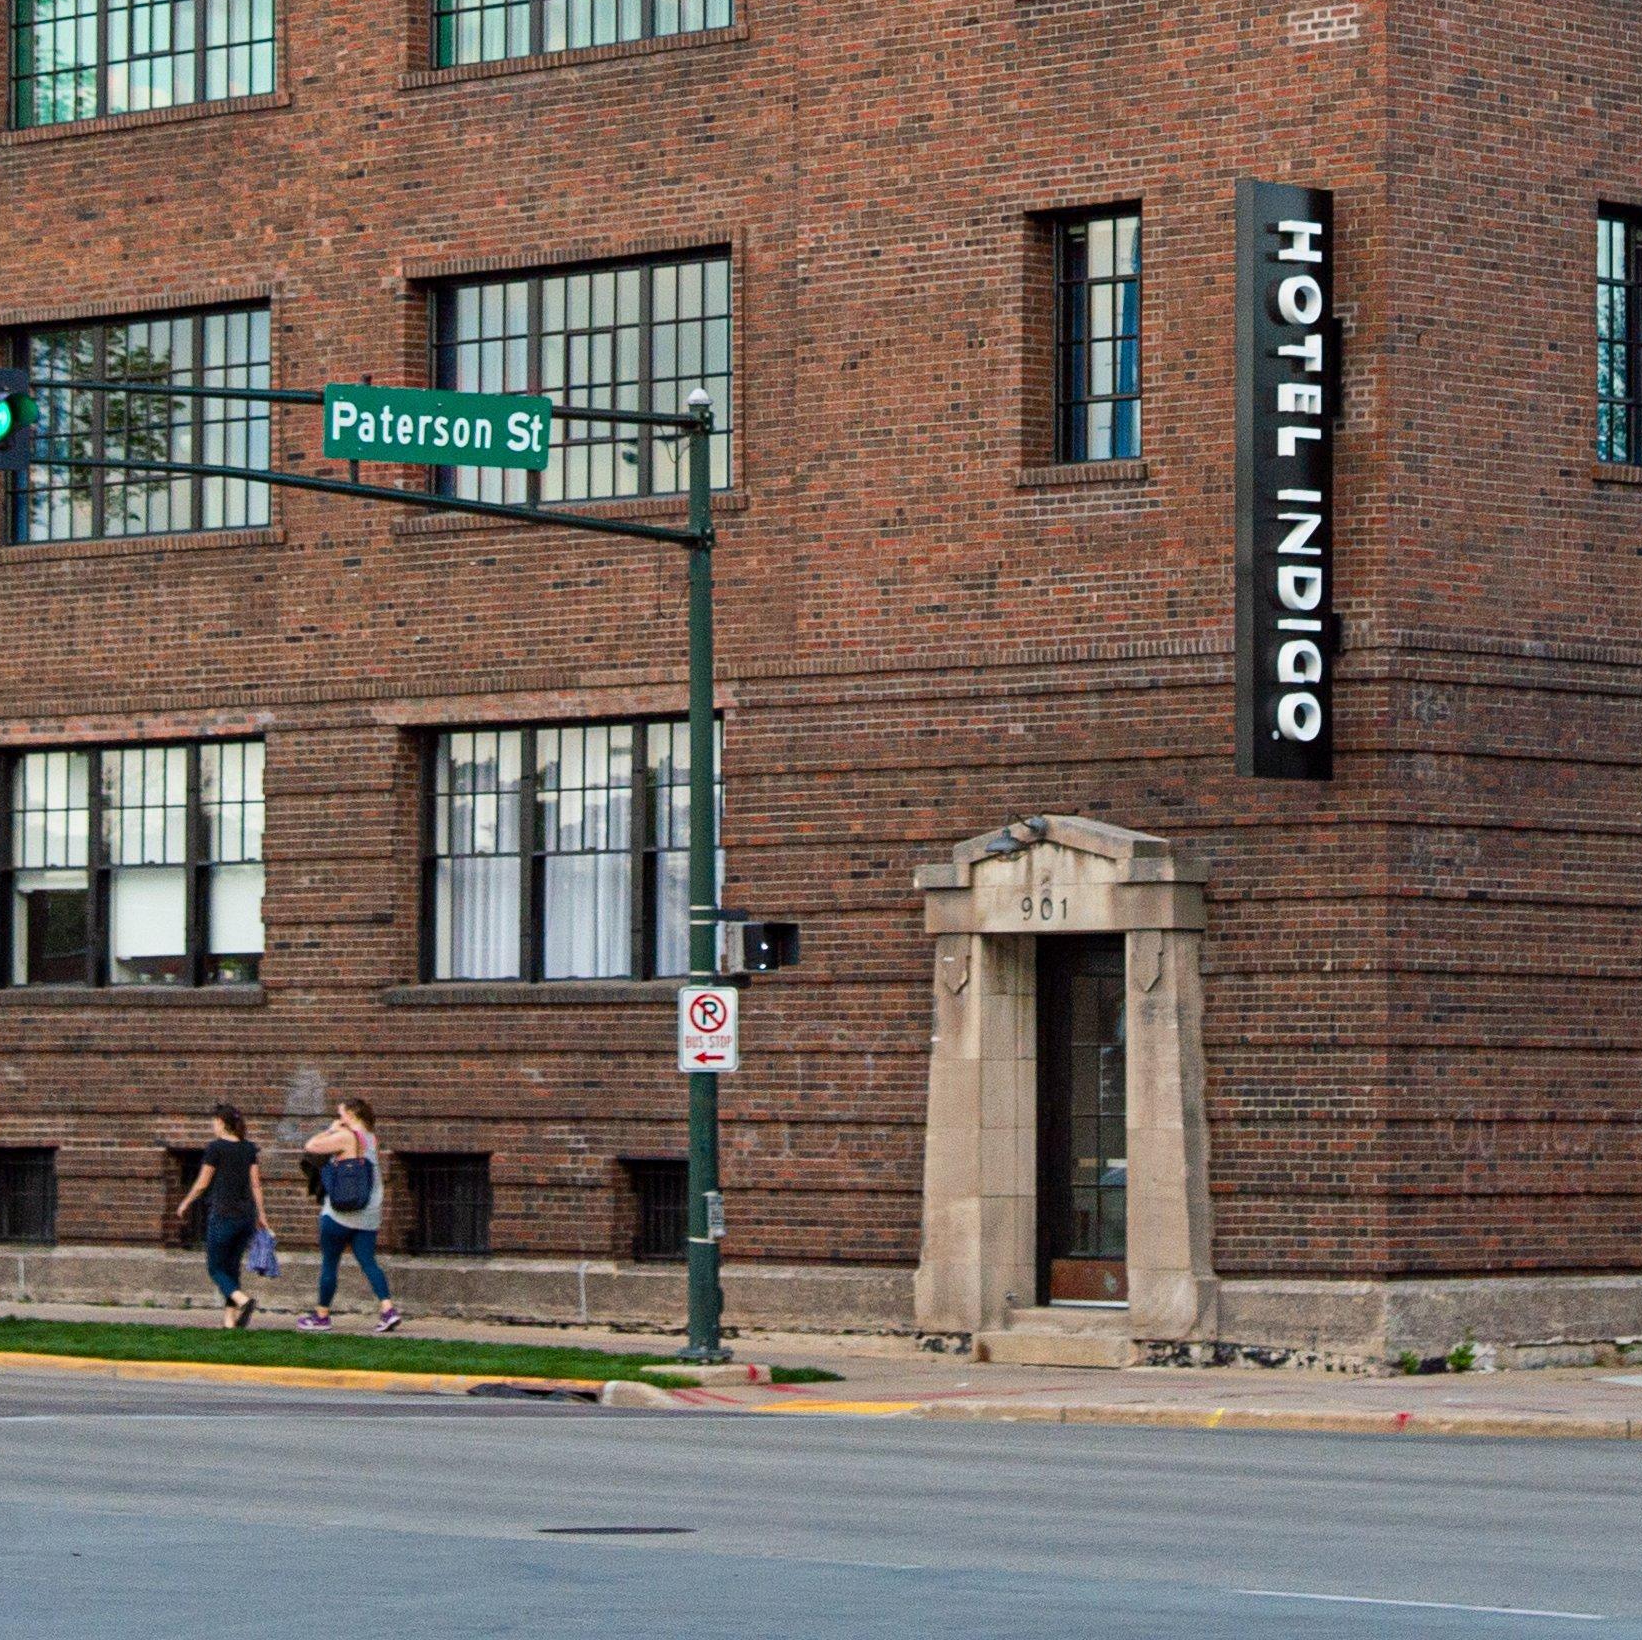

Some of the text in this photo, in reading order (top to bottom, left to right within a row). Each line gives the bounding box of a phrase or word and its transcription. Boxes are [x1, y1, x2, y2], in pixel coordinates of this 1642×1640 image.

[1277, 220, 1323, 457] HOTEL
[332, 401, 544, 453] Paterson St
[1021, 896, 1068, 921] 901
[685, 1035, 733, 1049] BUS STOP
